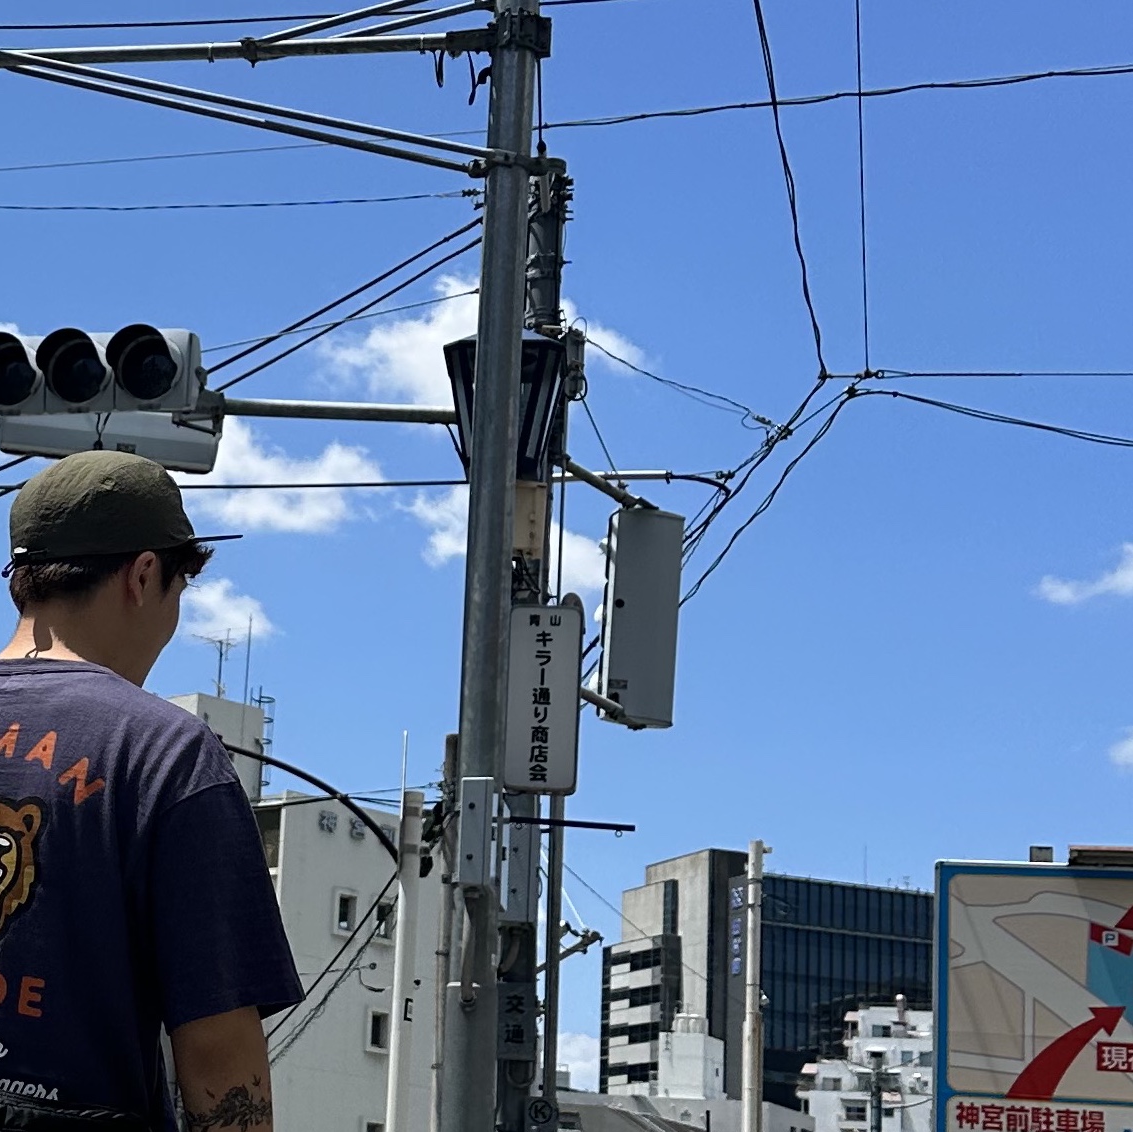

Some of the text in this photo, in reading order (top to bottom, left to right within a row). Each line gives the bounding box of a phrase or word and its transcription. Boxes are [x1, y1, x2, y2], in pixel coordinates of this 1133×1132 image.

[529, 614, 562, 627] 青山
[529, 631, 554, 783] キラー通り商店会
[504, 995, 526, 1045] 交通
